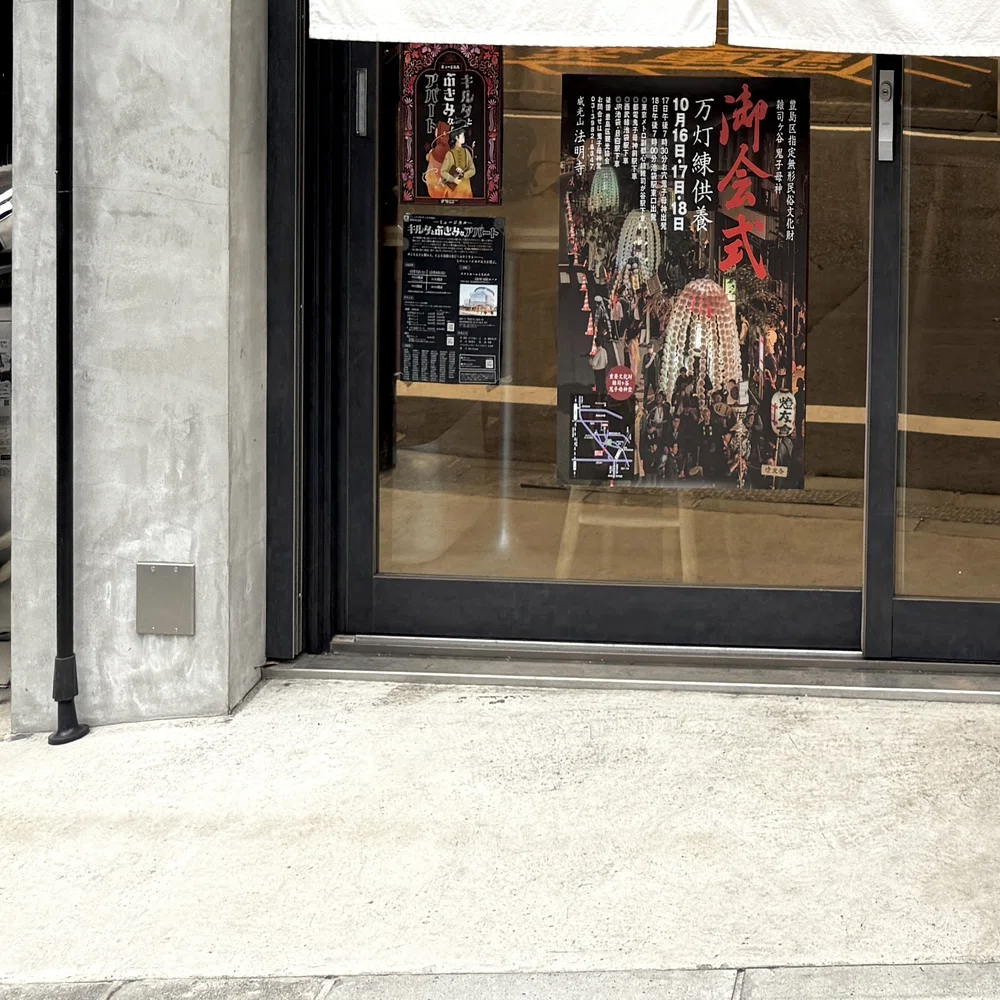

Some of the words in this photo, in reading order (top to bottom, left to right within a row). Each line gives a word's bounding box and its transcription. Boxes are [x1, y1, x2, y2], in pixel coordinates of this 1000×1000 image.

[424, 73, 440, 133] アパート
[574, 129, 586, 176] 法明寺
[671, 97, 689, 231] 10月16日・17日・18日
[692, 97, 715, 232] 万灯練供養
[785, 99, 798, 241] 豊島区指定無形民俗文化財
[717, 83, 773, 281] 御会式
